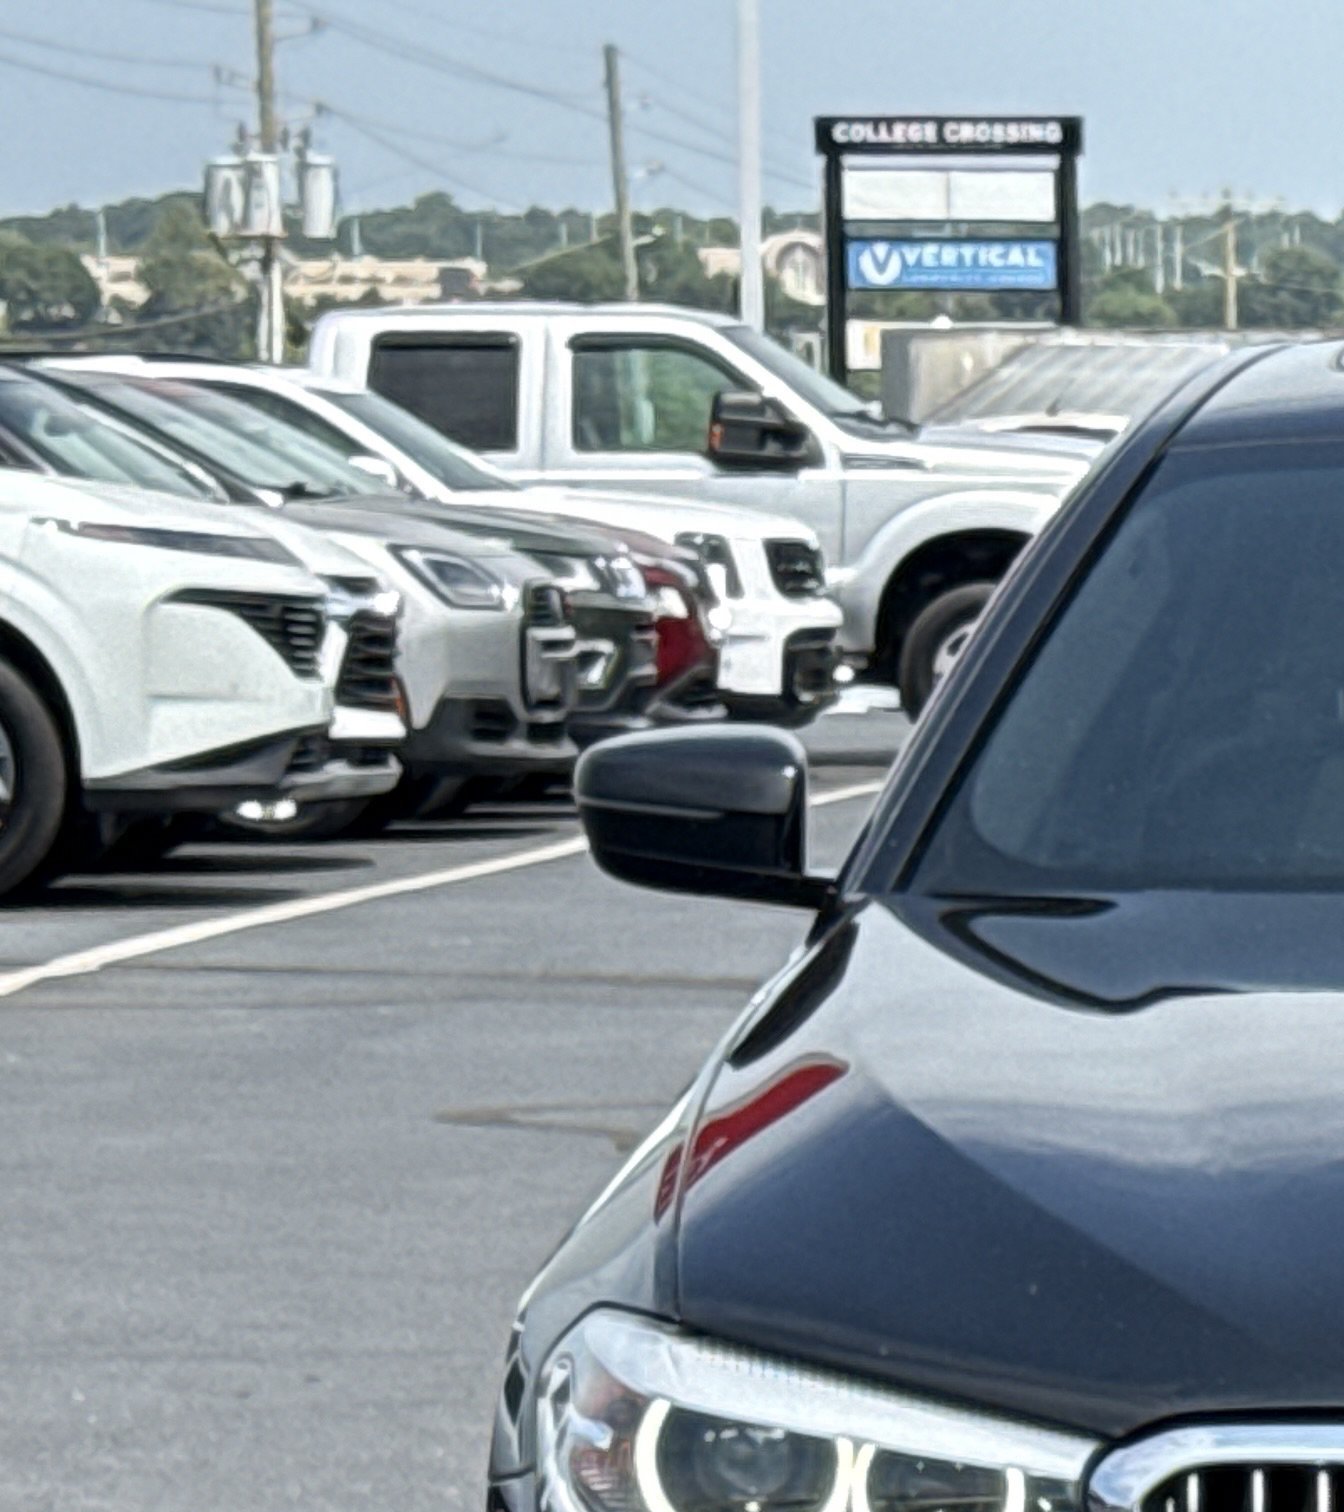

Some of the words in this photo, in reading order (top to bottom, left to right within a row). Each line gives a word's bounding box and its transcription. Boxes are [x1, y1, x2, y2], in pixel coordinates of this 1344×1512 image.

[832, 121, 938, 143] COLLEGE
[943, 121, 1062, 144] CROSSING
[903, 245, 1045, 268] VERTICAL
